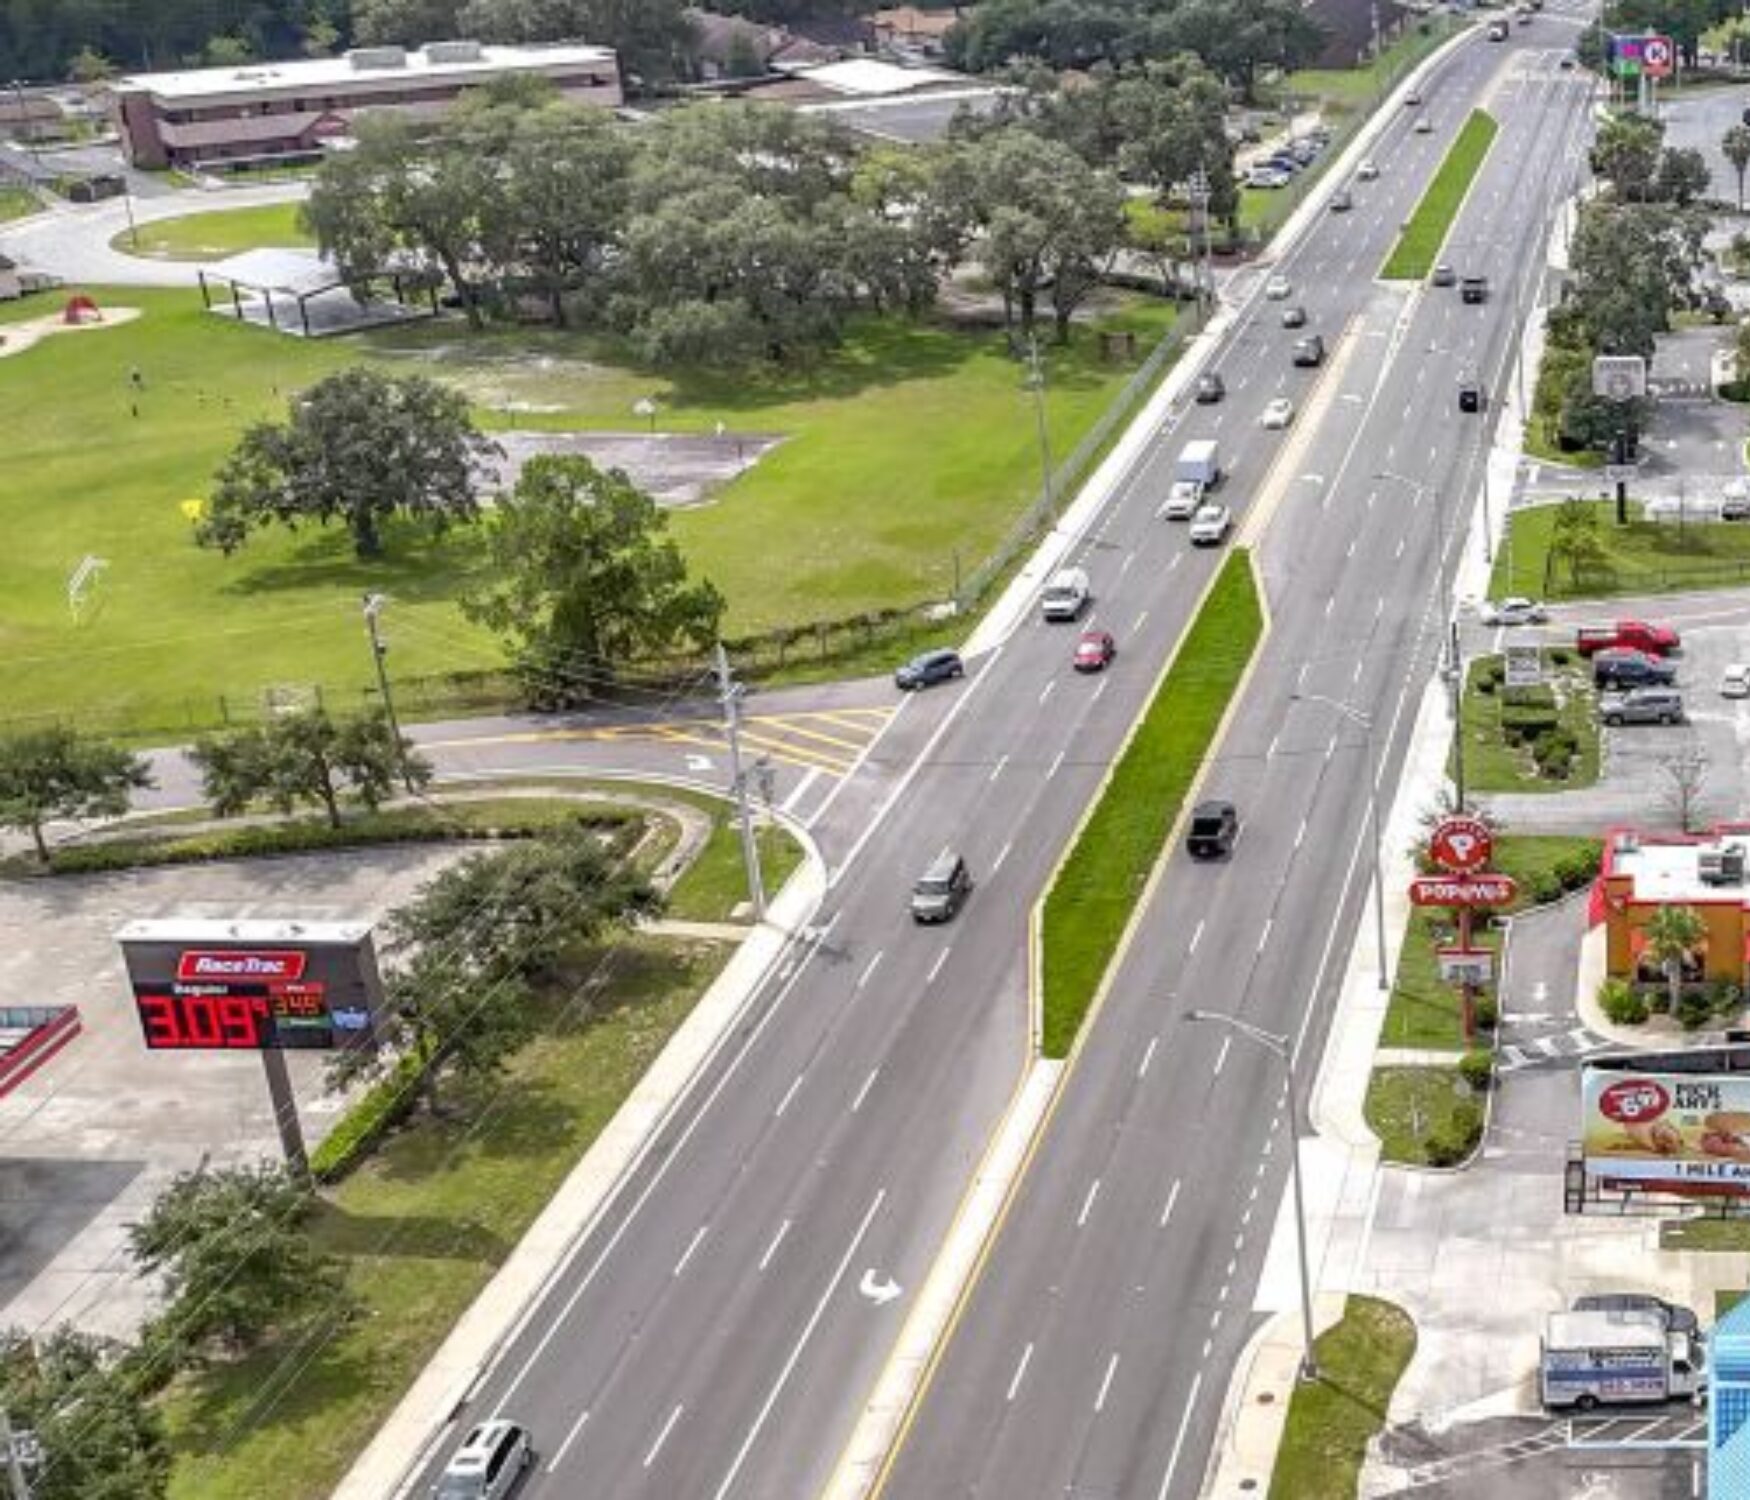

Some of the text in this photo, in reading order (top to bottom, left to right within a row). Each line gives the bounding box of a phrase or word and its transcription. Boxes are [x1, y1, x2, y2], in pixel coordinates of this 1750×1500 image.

[195, 957, 287, 974] RaceTrac
[174, 984, 229, 997] Regular
[1675, 1083, 1721, 1098] PICK
[1673, 1096, 1712, 1110] ANY
[1686, 1163, 1726, 1178] MILE
